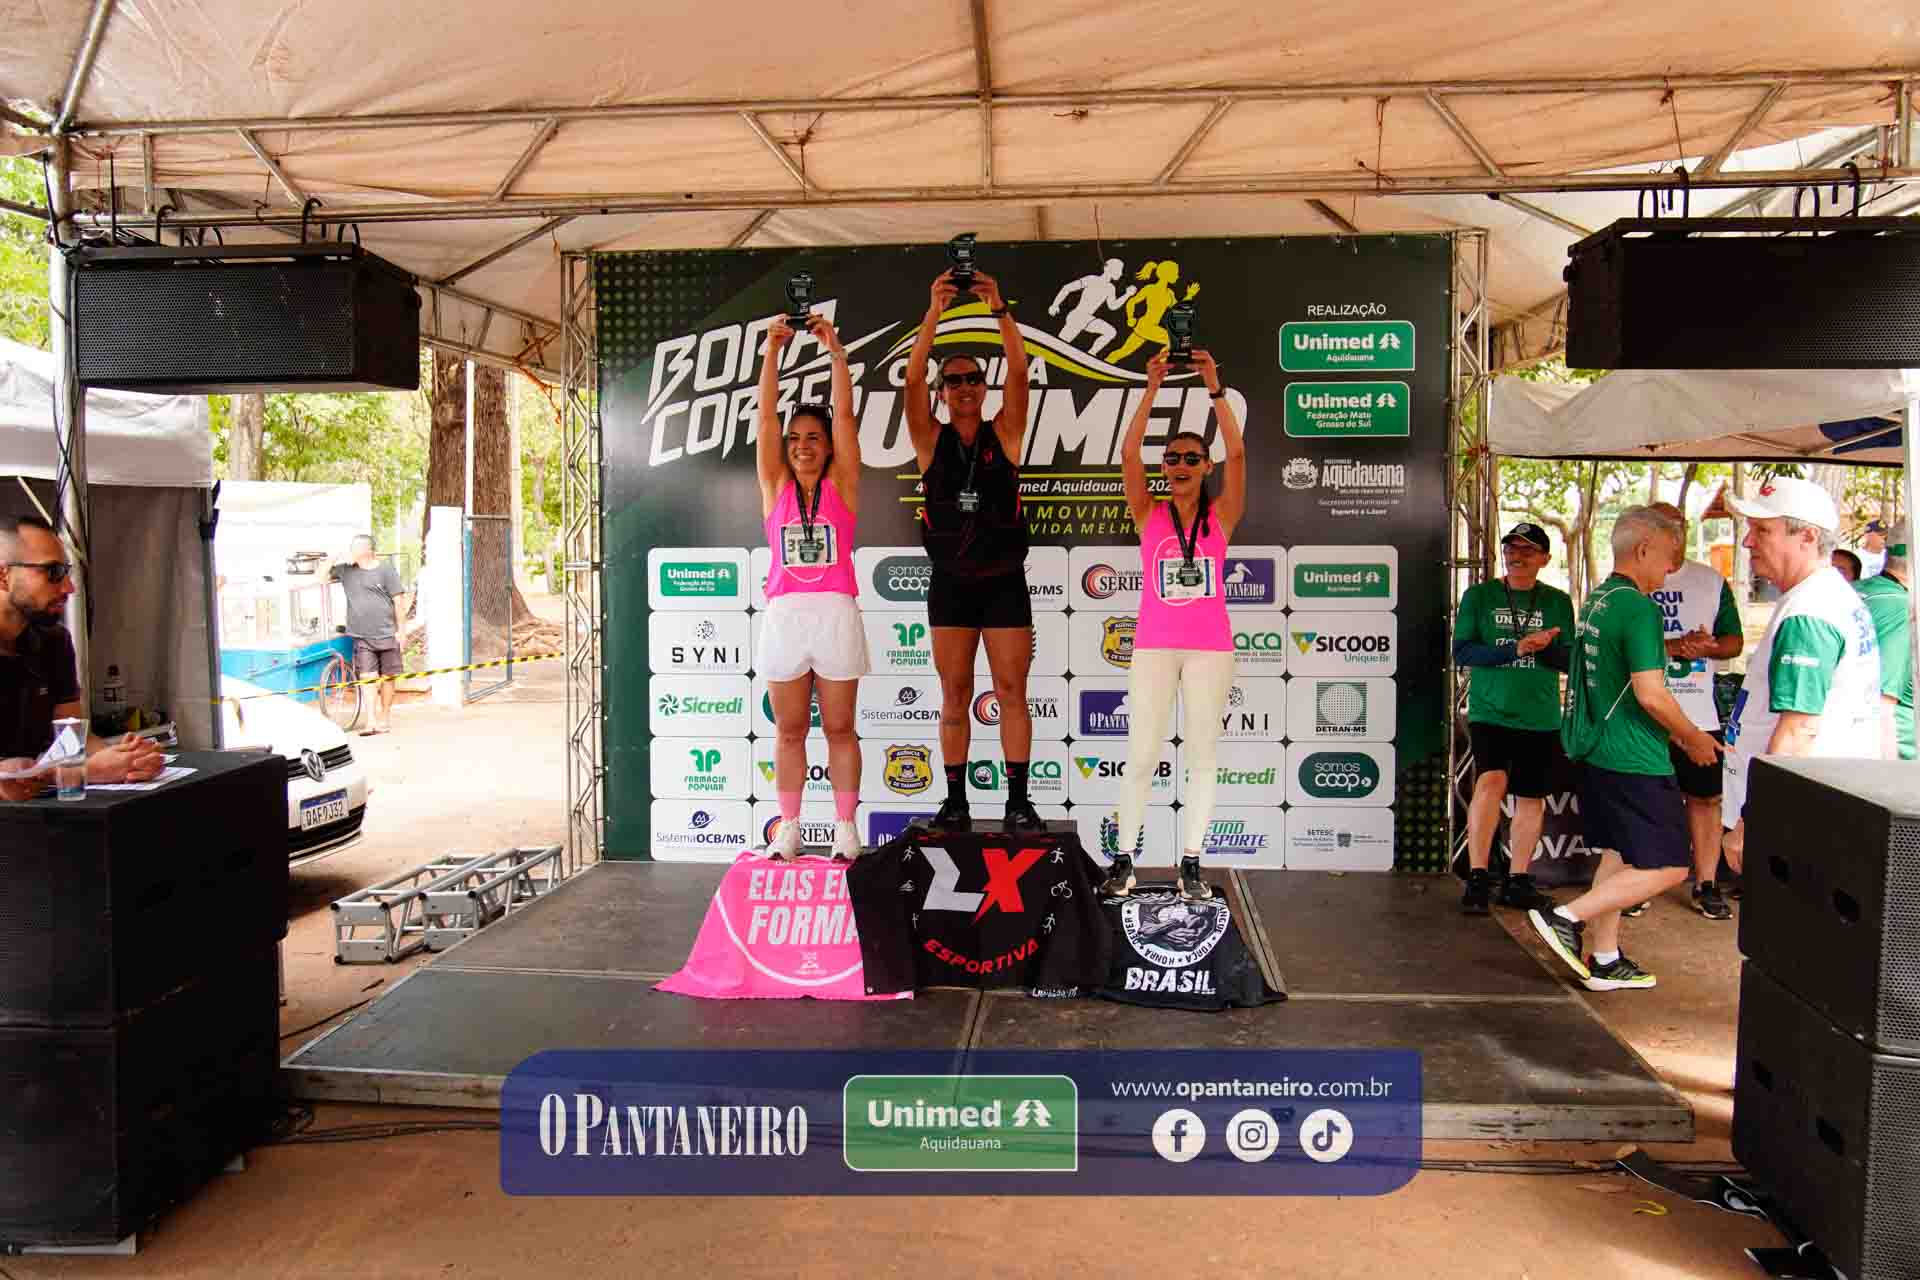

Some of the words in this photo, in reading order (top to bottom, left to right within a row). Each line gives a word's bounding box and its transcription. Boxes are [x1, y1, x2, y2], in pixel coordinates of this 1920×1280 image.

[1307, 302, 1387, 317] REALIZAÇÃO
[1293, 332, 1375, 350] Unimed
[1297, 392, 1372, 409] Unimed
[1321, 460, 1405, 490] Aquidauana
[1018, 480, 1048, 494] med
[1051, 480, 1127, 496] Aquidauan
[1037, 505, 1133, 520] MOVIME
[1029, 523, 1073, 536] VIDA
[1080, 522, 1141, 536] MELH
[667, 567, 715, 579] Unimed
[888, 565, 933, 576] somos
[1303, 571, 1362, 584] Unimed
[1099, 576, 1145, 592] SERIE
[1315, 635, 1390, 653] SICOOB
[672, 647, 740, 663] SYNI
[682, 696, 744, 714] Sicredi
[1099, 761, 1172, 777] SICB
[1314, 762, 1361, 772] somos
[656, 832, 746, 844] SistemaOCB/MS
[748, 868, 815, 901] ELAS
[922, 936, 1040, 976] ESPORTIVA
[1124, 966, 1217, 995] BRASIL
